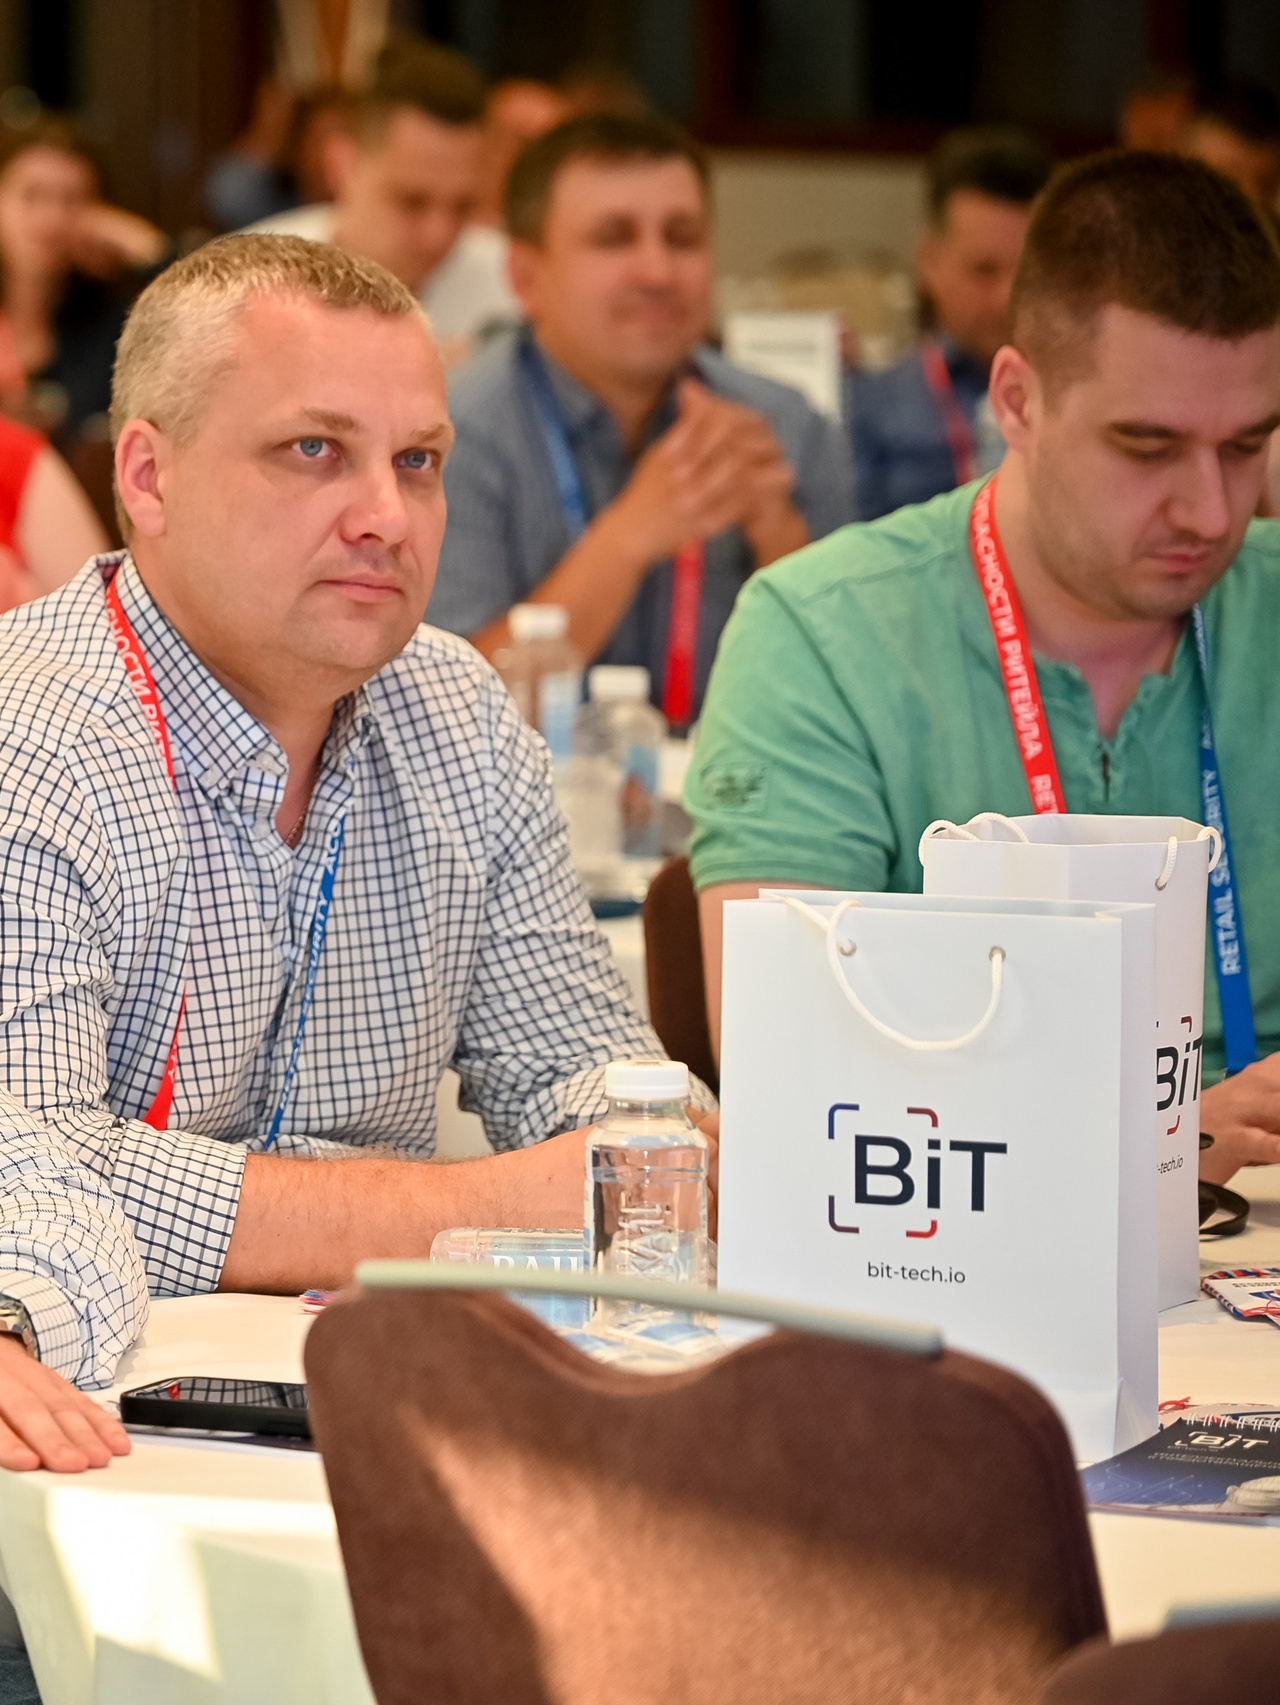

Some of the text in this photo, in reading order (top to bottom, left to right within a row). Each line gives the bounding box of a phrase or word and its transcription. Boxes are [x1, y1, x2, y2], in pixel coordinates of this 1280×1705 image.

[1001, 639, 1043, 760] РИТЕЙЛА
[1213, 887, 1241, 976] RETAIL
[854, 1134, 1008, 1212] BiT
[1156, 1154, 1184, 1174] -tech.io
[867, 1261, 966, 1284] bit-tech.io
